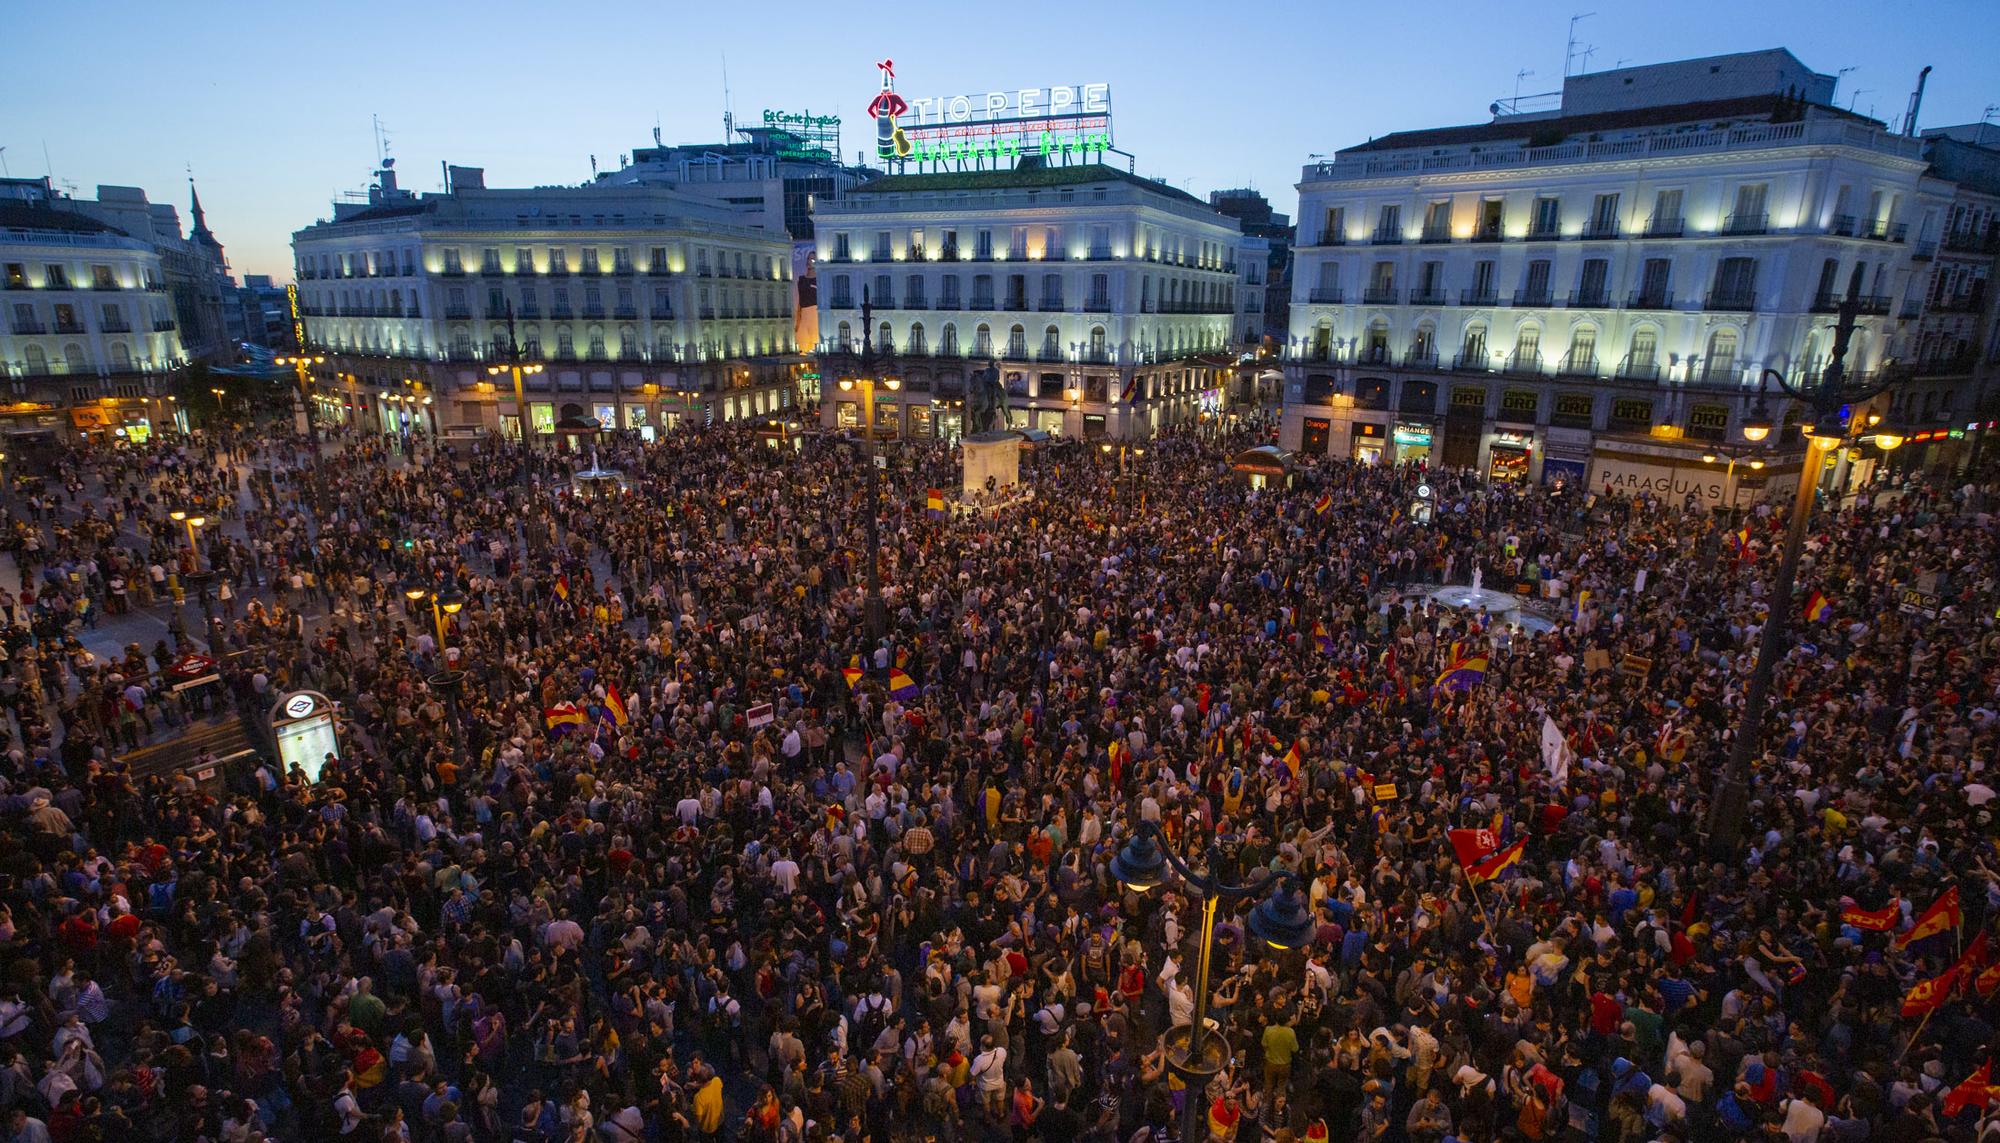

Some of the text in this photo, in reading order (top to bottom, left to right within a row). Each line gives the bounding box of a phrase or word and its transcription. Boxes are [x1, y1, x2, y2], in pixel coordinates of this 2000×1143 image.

[986, 83, 1108, 120] PEPE
[763, 109, 842, 129] El Corte Inglés
[776, 150, 831, 160] SUPERMERCADO
[1452, 393, 1485, 405] ORO
[1503, 398, 1536, 409] ORO
[1557, 402, 1592, 413] ORO
[1613, 407, 1651, 419] ORO
[1306, 419, 1329, 430] Orange
[1691, 413, 1727, 426] ORO
[1398, 426, 1431, 435] CHANGE
[1601, 470, 1721, 499] PARAGUAS
